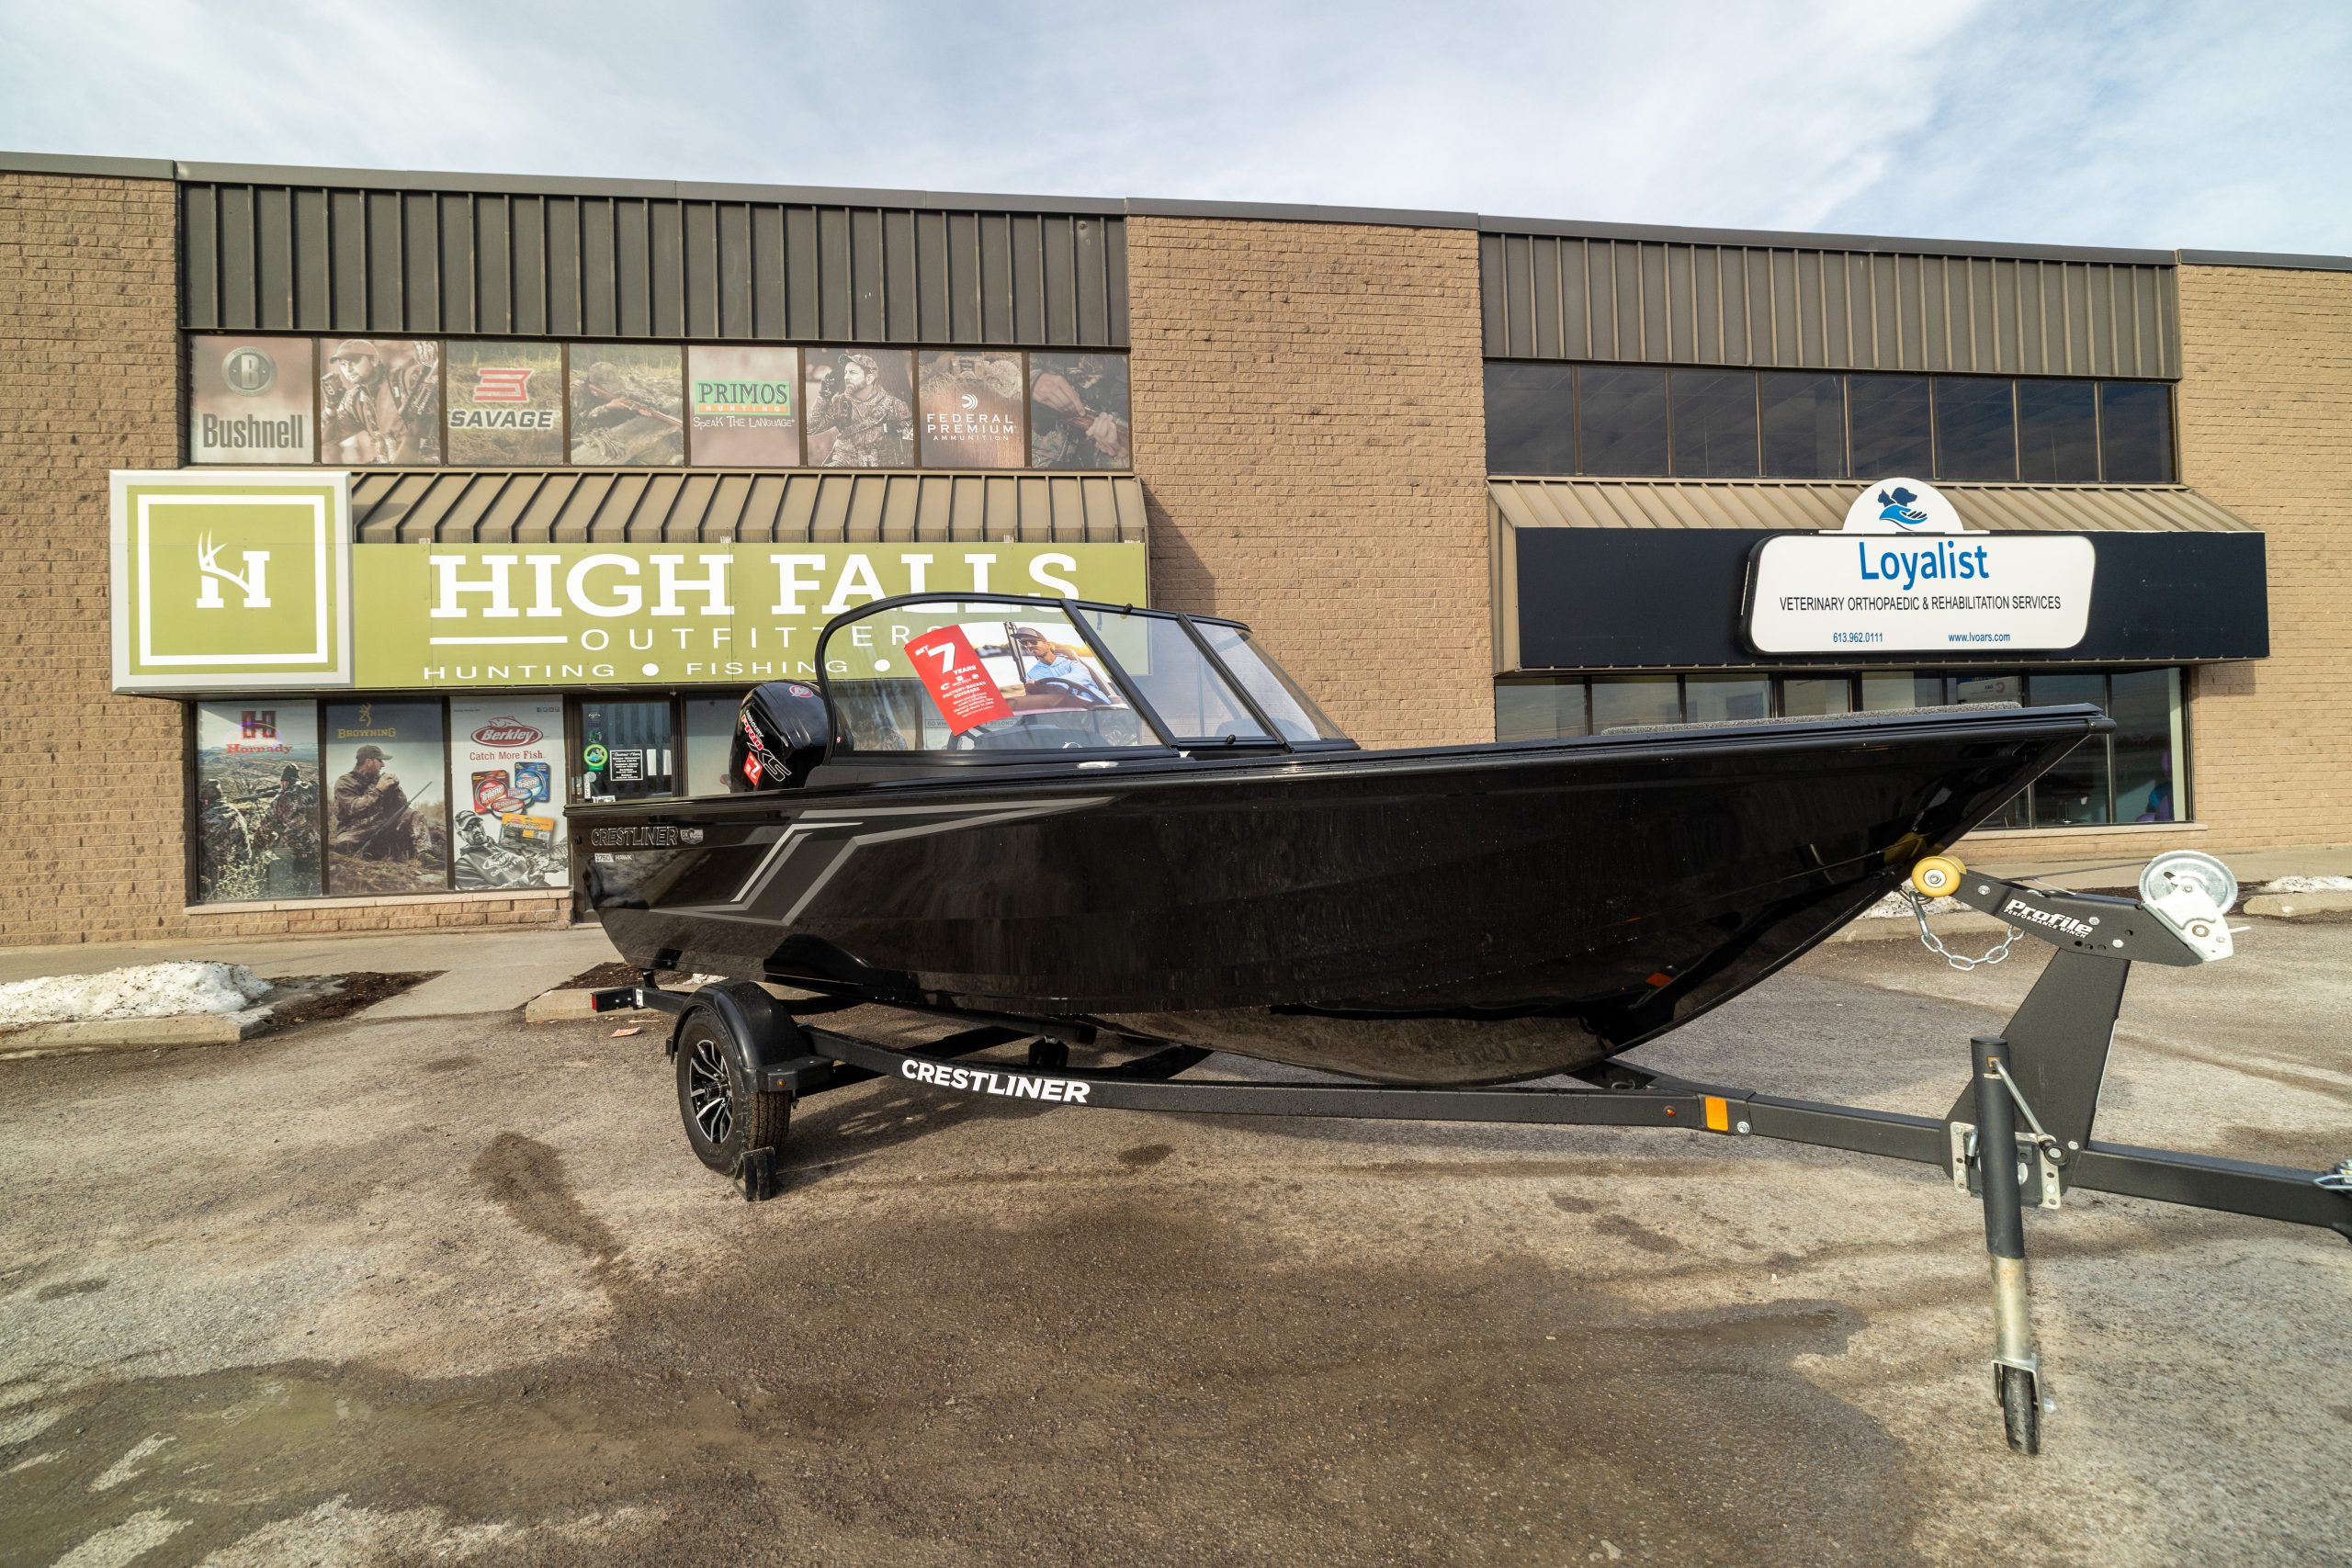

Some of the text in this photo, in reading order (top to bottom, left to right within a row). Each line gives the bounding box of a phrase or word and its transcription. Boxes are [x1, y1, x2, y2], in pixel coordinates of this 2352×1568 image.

[697, 382, 787, 404] PRIMOS
[450, 410, 553, 430] SAVAGE
[926, 413, 1014, 423] FEDERAL
[202, 413, 304, 449] Bushnell
[927, 423, 1014, 434] PREMIUM
[1859, 540, 1990, 591] Loyalist
[429, 552, 1080, 618] HIGH FALLS
[1780, 595, 2061, 611] VETERINARY ORTHOPAEDIC & REHABILITATION SERVICES
[581, 626, 944, 651] OUTFITTER
[1832, 632, 1883, 643] 613.962.0111
[1948, 631, 2011, 643] www.lvoars.com
[927, 641, 956, 674] 7
[424, 660, 848, 681] HUNTING FISHING
[953, 664, 977, 675] YEARS
[242, 710, 277, 739] H
[337, 728, 398, 739] BROWNING
[481, 728, 534, 745] Berkley
[226, 743, 293, 755] Hornady
[469, 752, 495, 761] Catch
[498, 751, 520, 760] More
[591, 826, 679, 846] CRESTLINER
[2004, 908, 2087, 938] PERFORMANCE WINCH
[2006, 898, 2094, 935] Profile
[901, 1057, 1091, 1103] CRESTLINER
